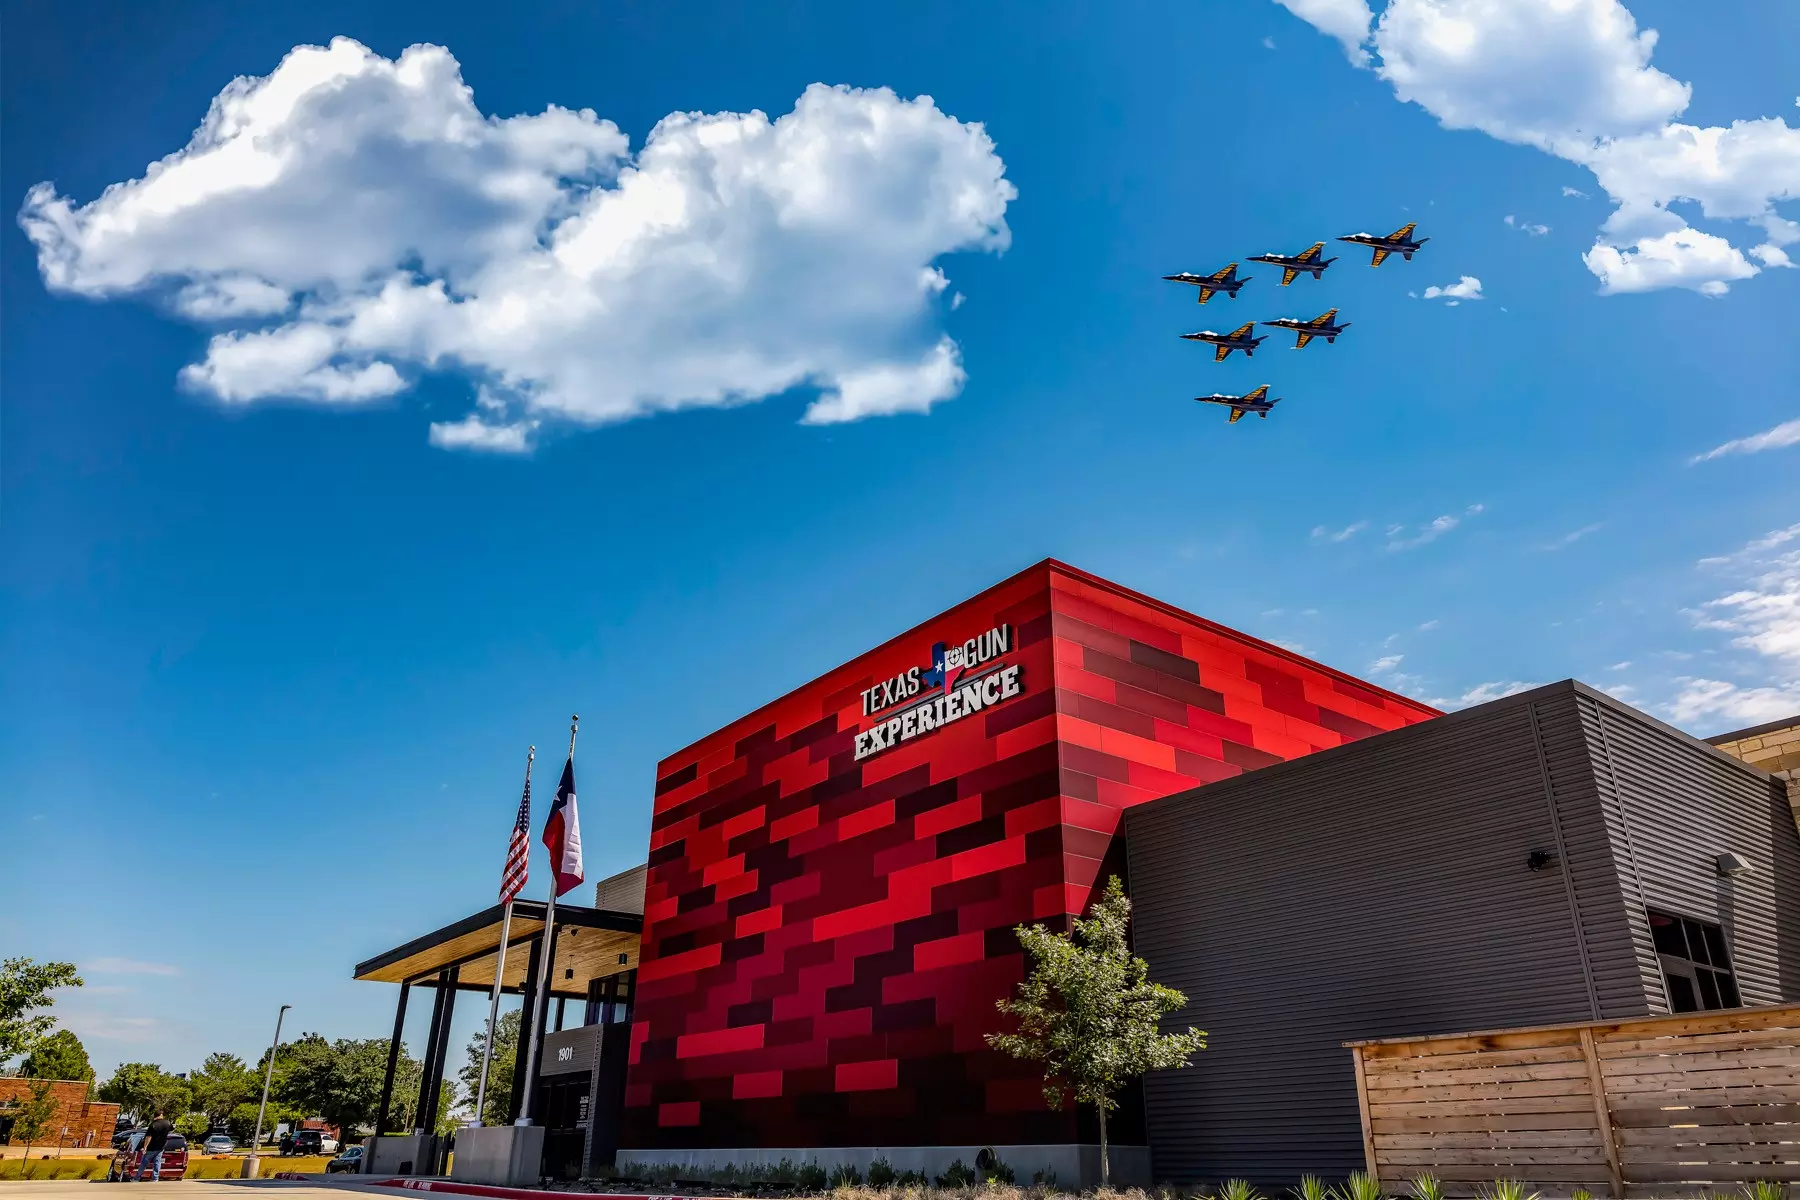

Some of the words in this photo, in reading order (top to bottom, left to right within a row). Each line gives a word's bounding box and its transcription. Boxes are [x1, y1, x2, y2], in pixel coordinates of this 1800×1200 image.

[854, 664, 1020, 761] EXPERIENCE
[860, 666, 920, 716] TEXAS
[963, 623, 1008, 669] GUN
[558, 1046, 573, 1061] 1901
